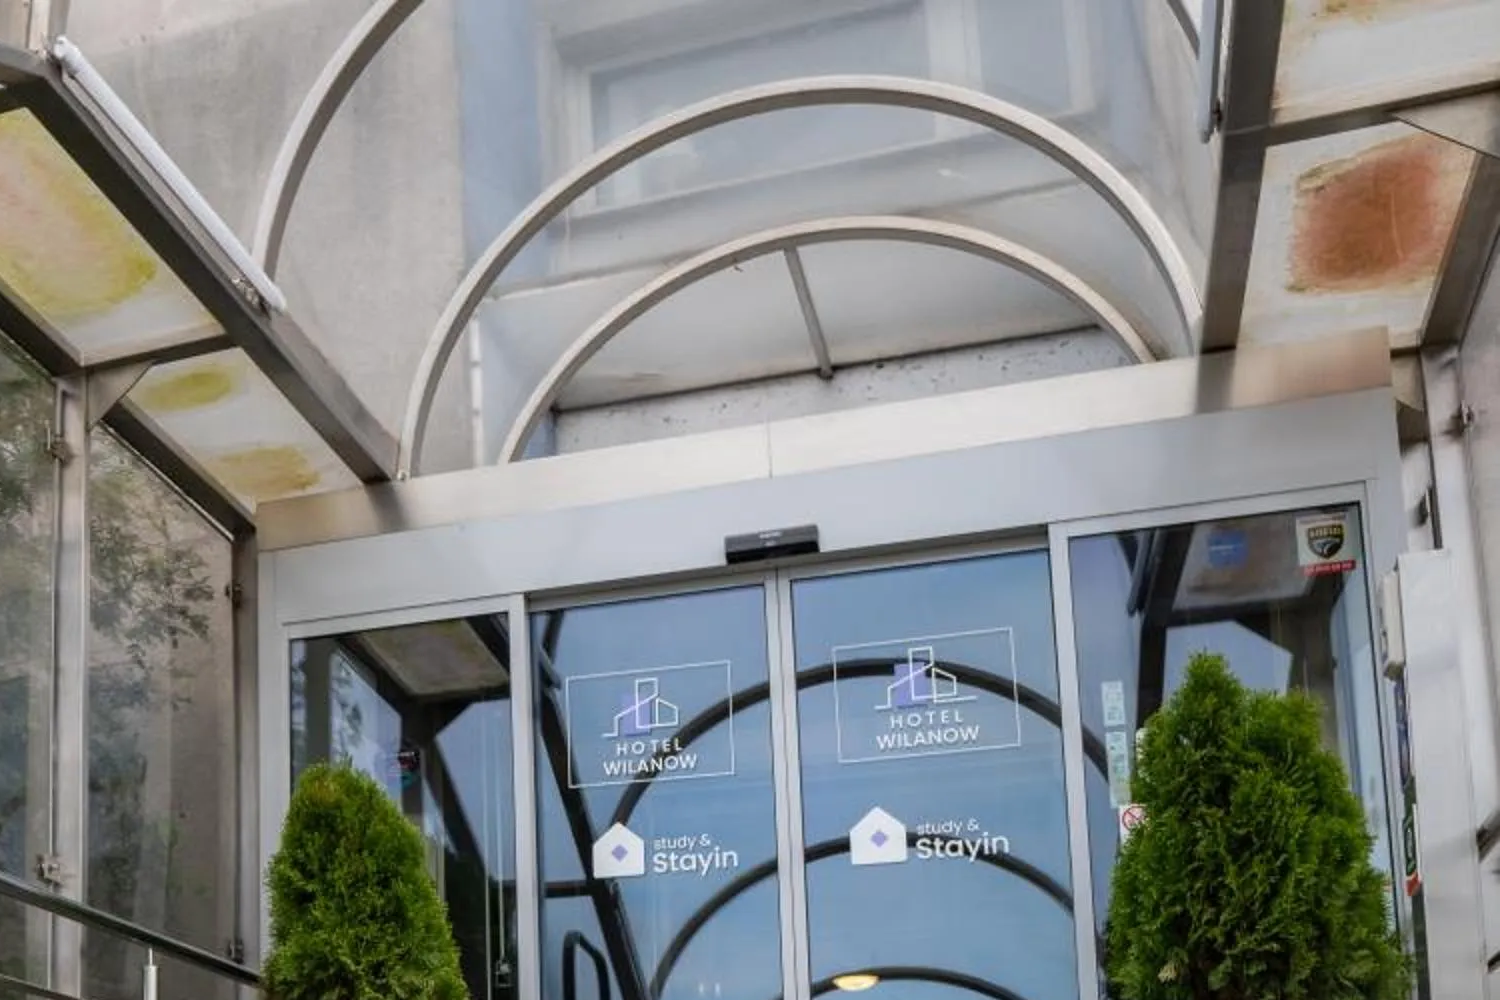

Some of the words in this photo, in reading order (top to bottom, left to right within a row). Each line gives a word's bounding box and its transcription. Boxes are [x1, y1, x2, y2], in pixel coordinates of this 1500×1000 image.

[889, 709, 964, 729] HOTEL
[615, 738, 683, 757] HOTEL
[875, 724, 981, 750] WILANOW
[603, 753, 698, 776] WILANOW
[916, 818, 963, 835] study
[967, 817, 981, 832] &
[654, 835, 696, 851] study
[700, 833, 711, 847] &
[915, 831, 1010, 863] Stayin
[653, 845, 739, 877] Stayin
